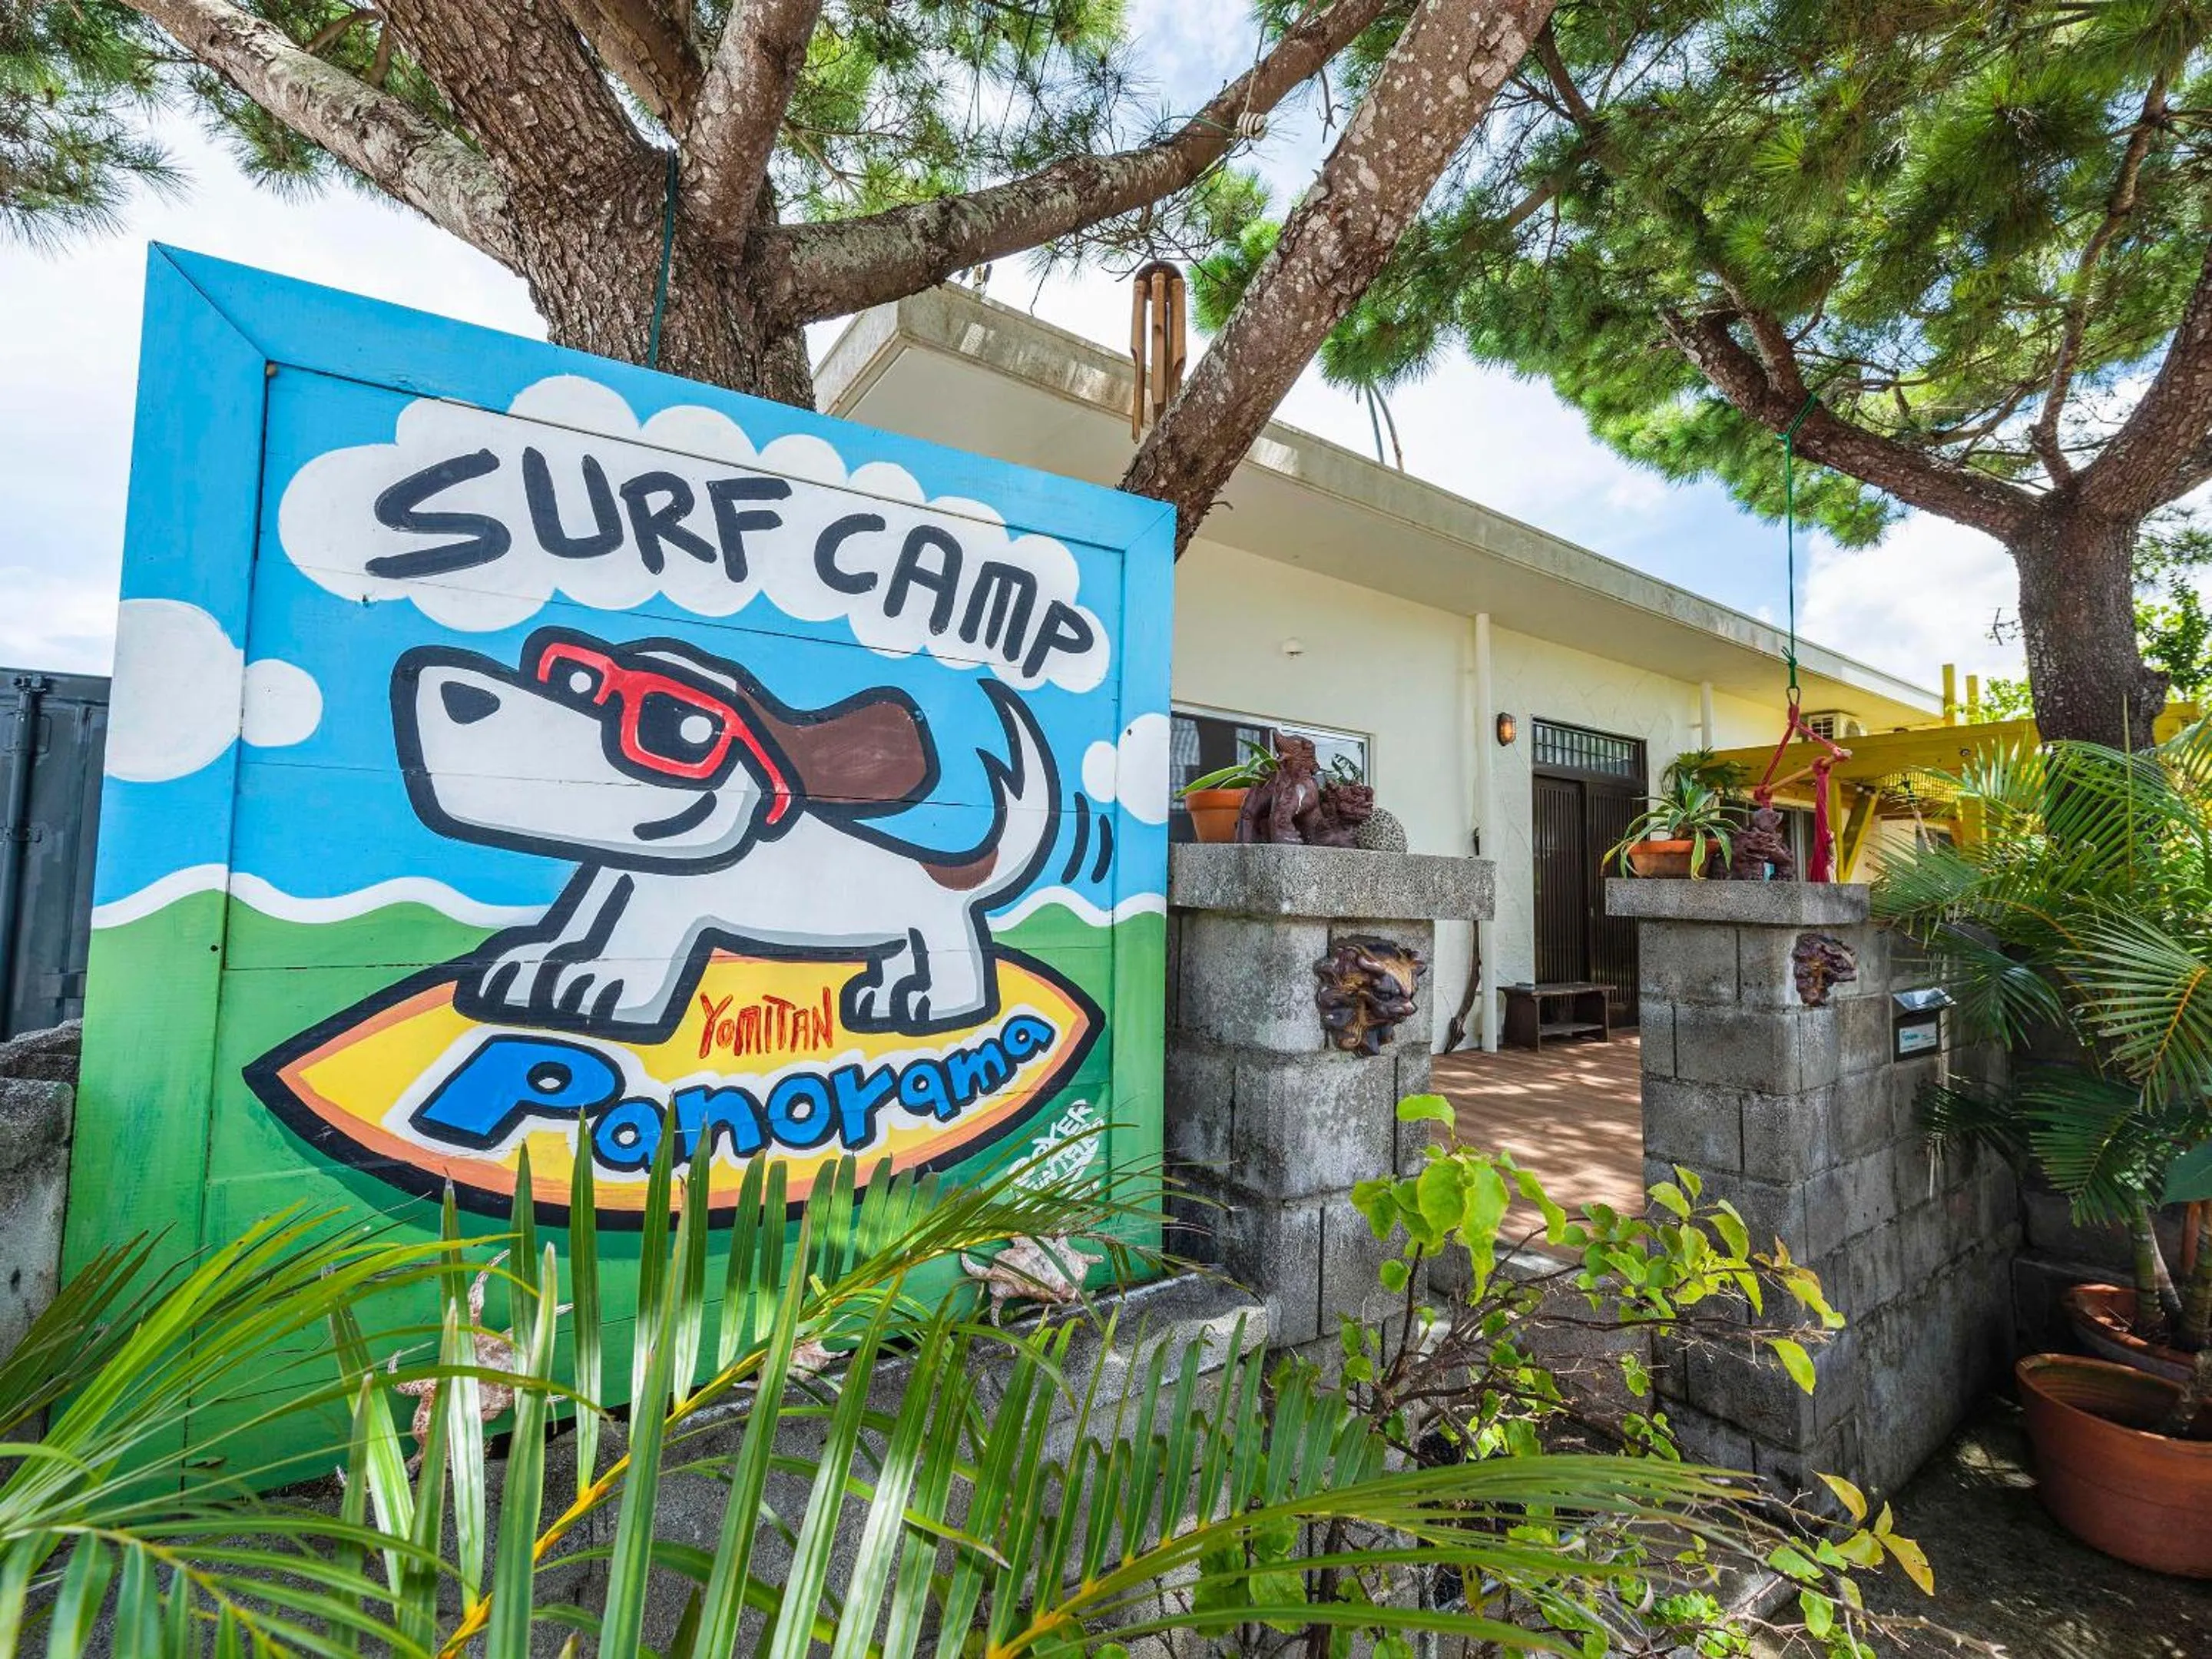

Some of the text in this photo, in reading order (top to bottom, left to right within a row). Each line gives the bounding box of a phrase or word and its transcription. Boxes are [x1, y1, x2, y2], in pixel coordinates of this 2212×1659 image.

[365, 447, 1094, 678] SURF CAMP
[408, 1013, 1055, 1174] Panorama
[699, 986, 834, 1059] YOMITAN
